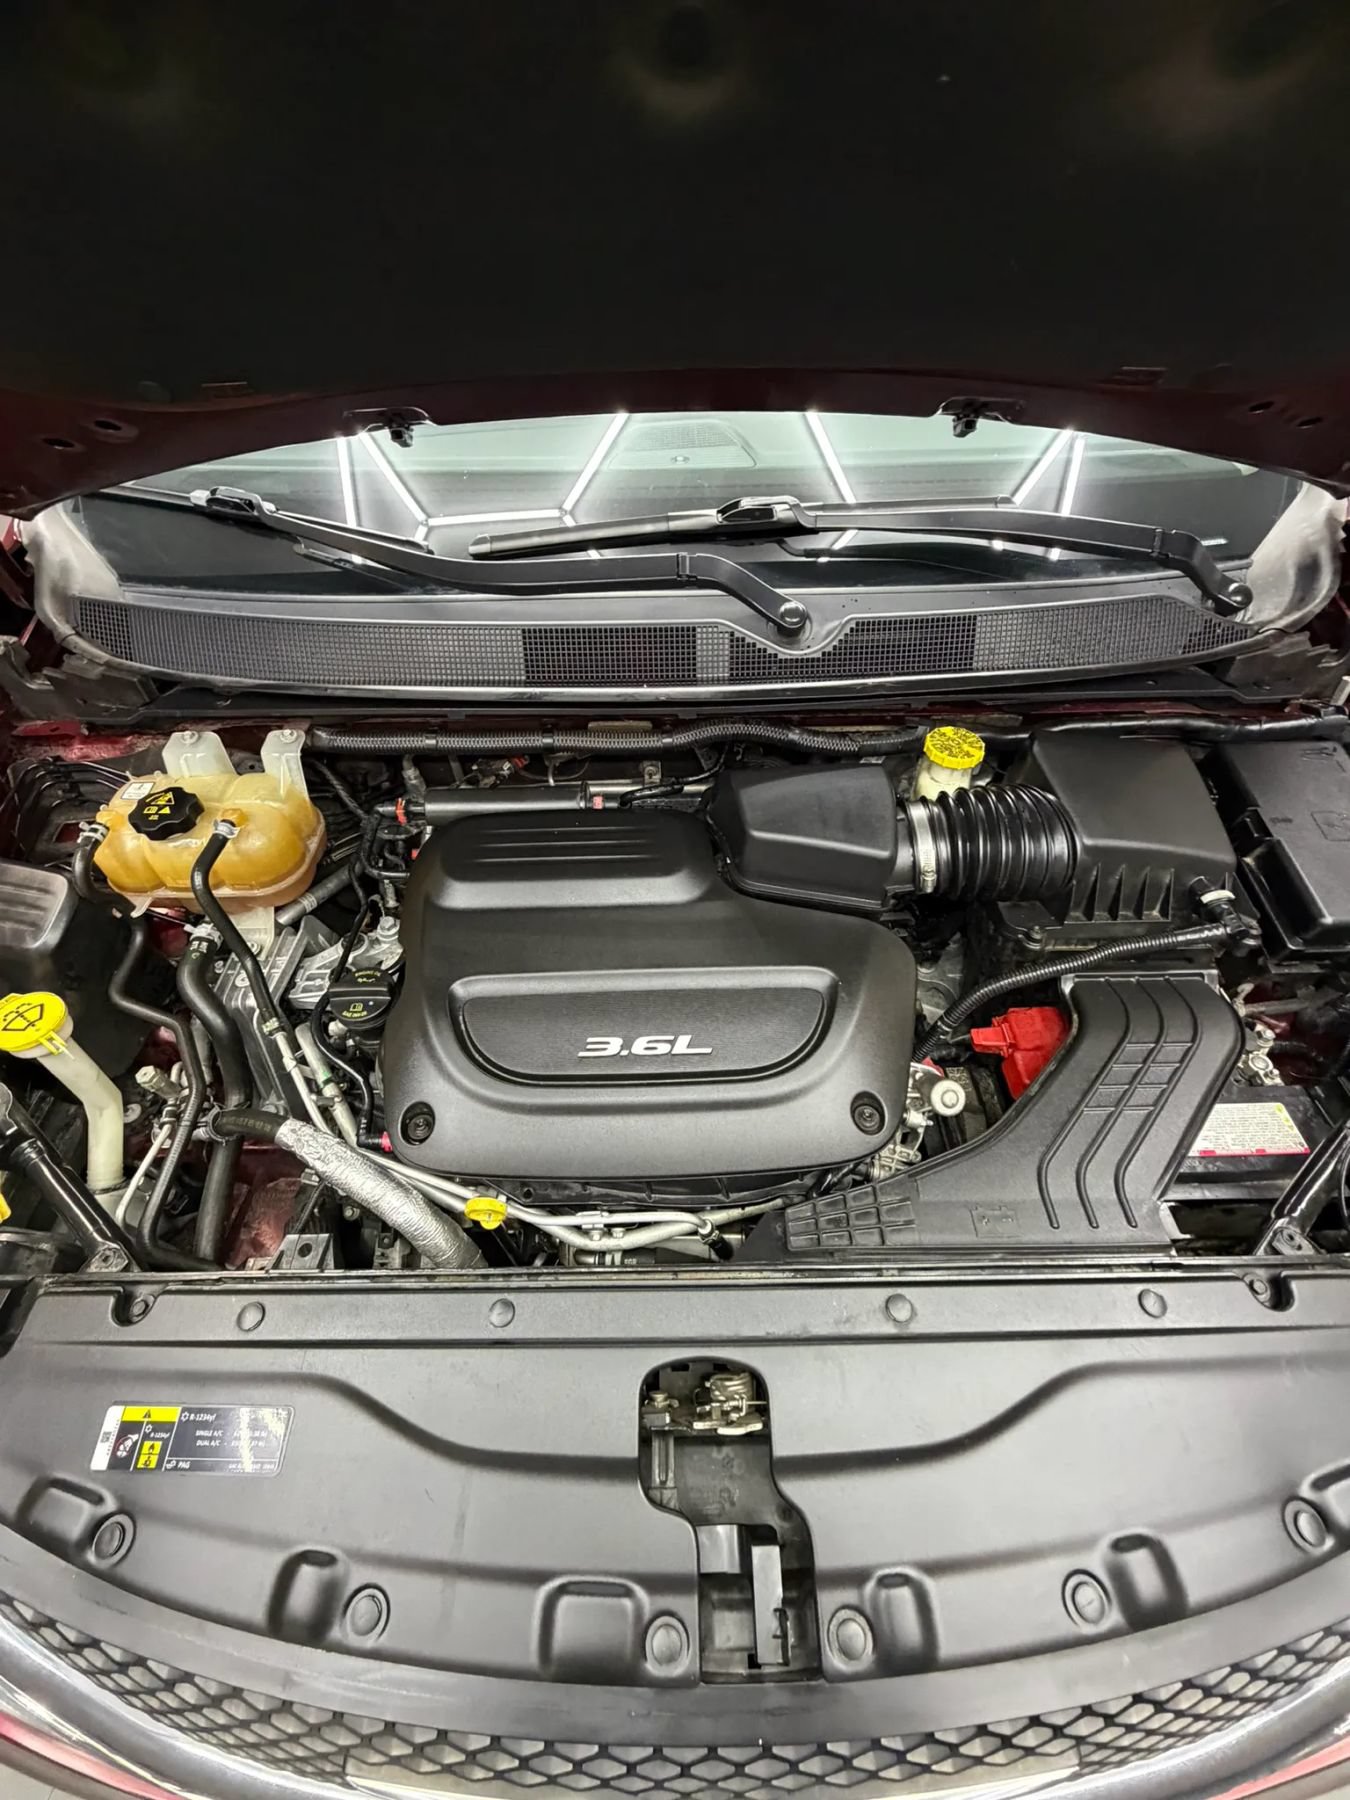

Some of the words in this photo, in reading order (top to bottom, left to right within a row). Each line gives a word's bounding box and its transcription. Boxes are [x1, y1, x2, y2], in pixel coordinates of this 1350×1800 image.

[577, 1034, 713, 1057] 3.6L
[189, 1412, 217, 1423] R-1234yf
[213, 1429, 224, 1437] A/C
[210, 1439, 222, 1447] A/C
[177, 1460, 191, 1469] PAG
